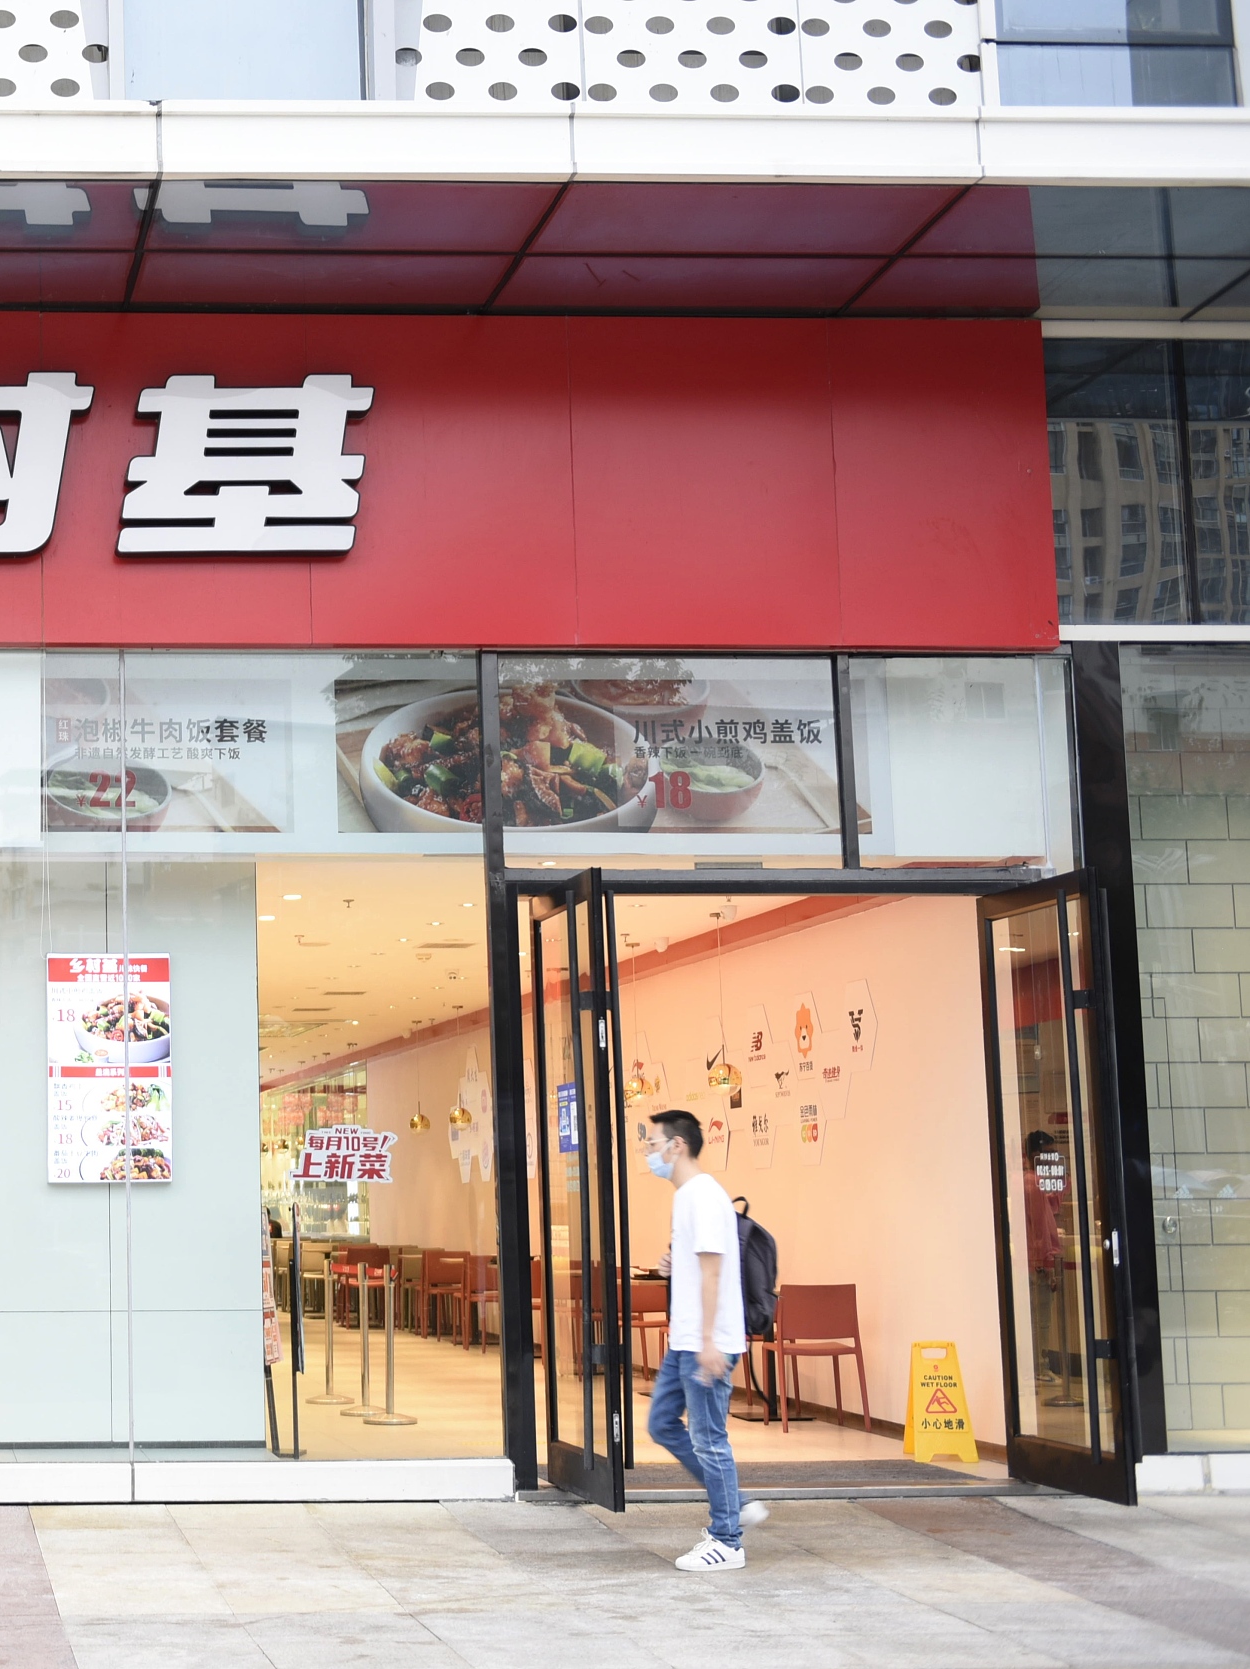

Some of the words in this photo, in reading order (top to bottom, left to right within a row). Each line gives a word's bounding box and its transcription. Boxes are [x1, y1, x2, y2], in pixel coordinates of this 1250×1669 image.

[58, 719, 69, 742] 红珠
[74, 718, 268, 743] 泡椒牛肉饭套餐
[633, 719, 823, 744] 川式小煎鸡盖饭
[186, 747, 241, 760] 酸爽下饭
[636, 770, 692, 810] ¥18
[57, 1009, 76, 1022] 18
[58, 1100, 73, 1111] 15
[334, 1127, 359, 1135] NEW
[58, 1133, 73, 1145] 18
[292, 1153, 388, 1180] 上新菜
[57, 1168, 71, 1179] 20
[921, 1418, 965, 1430] 小心地滑
